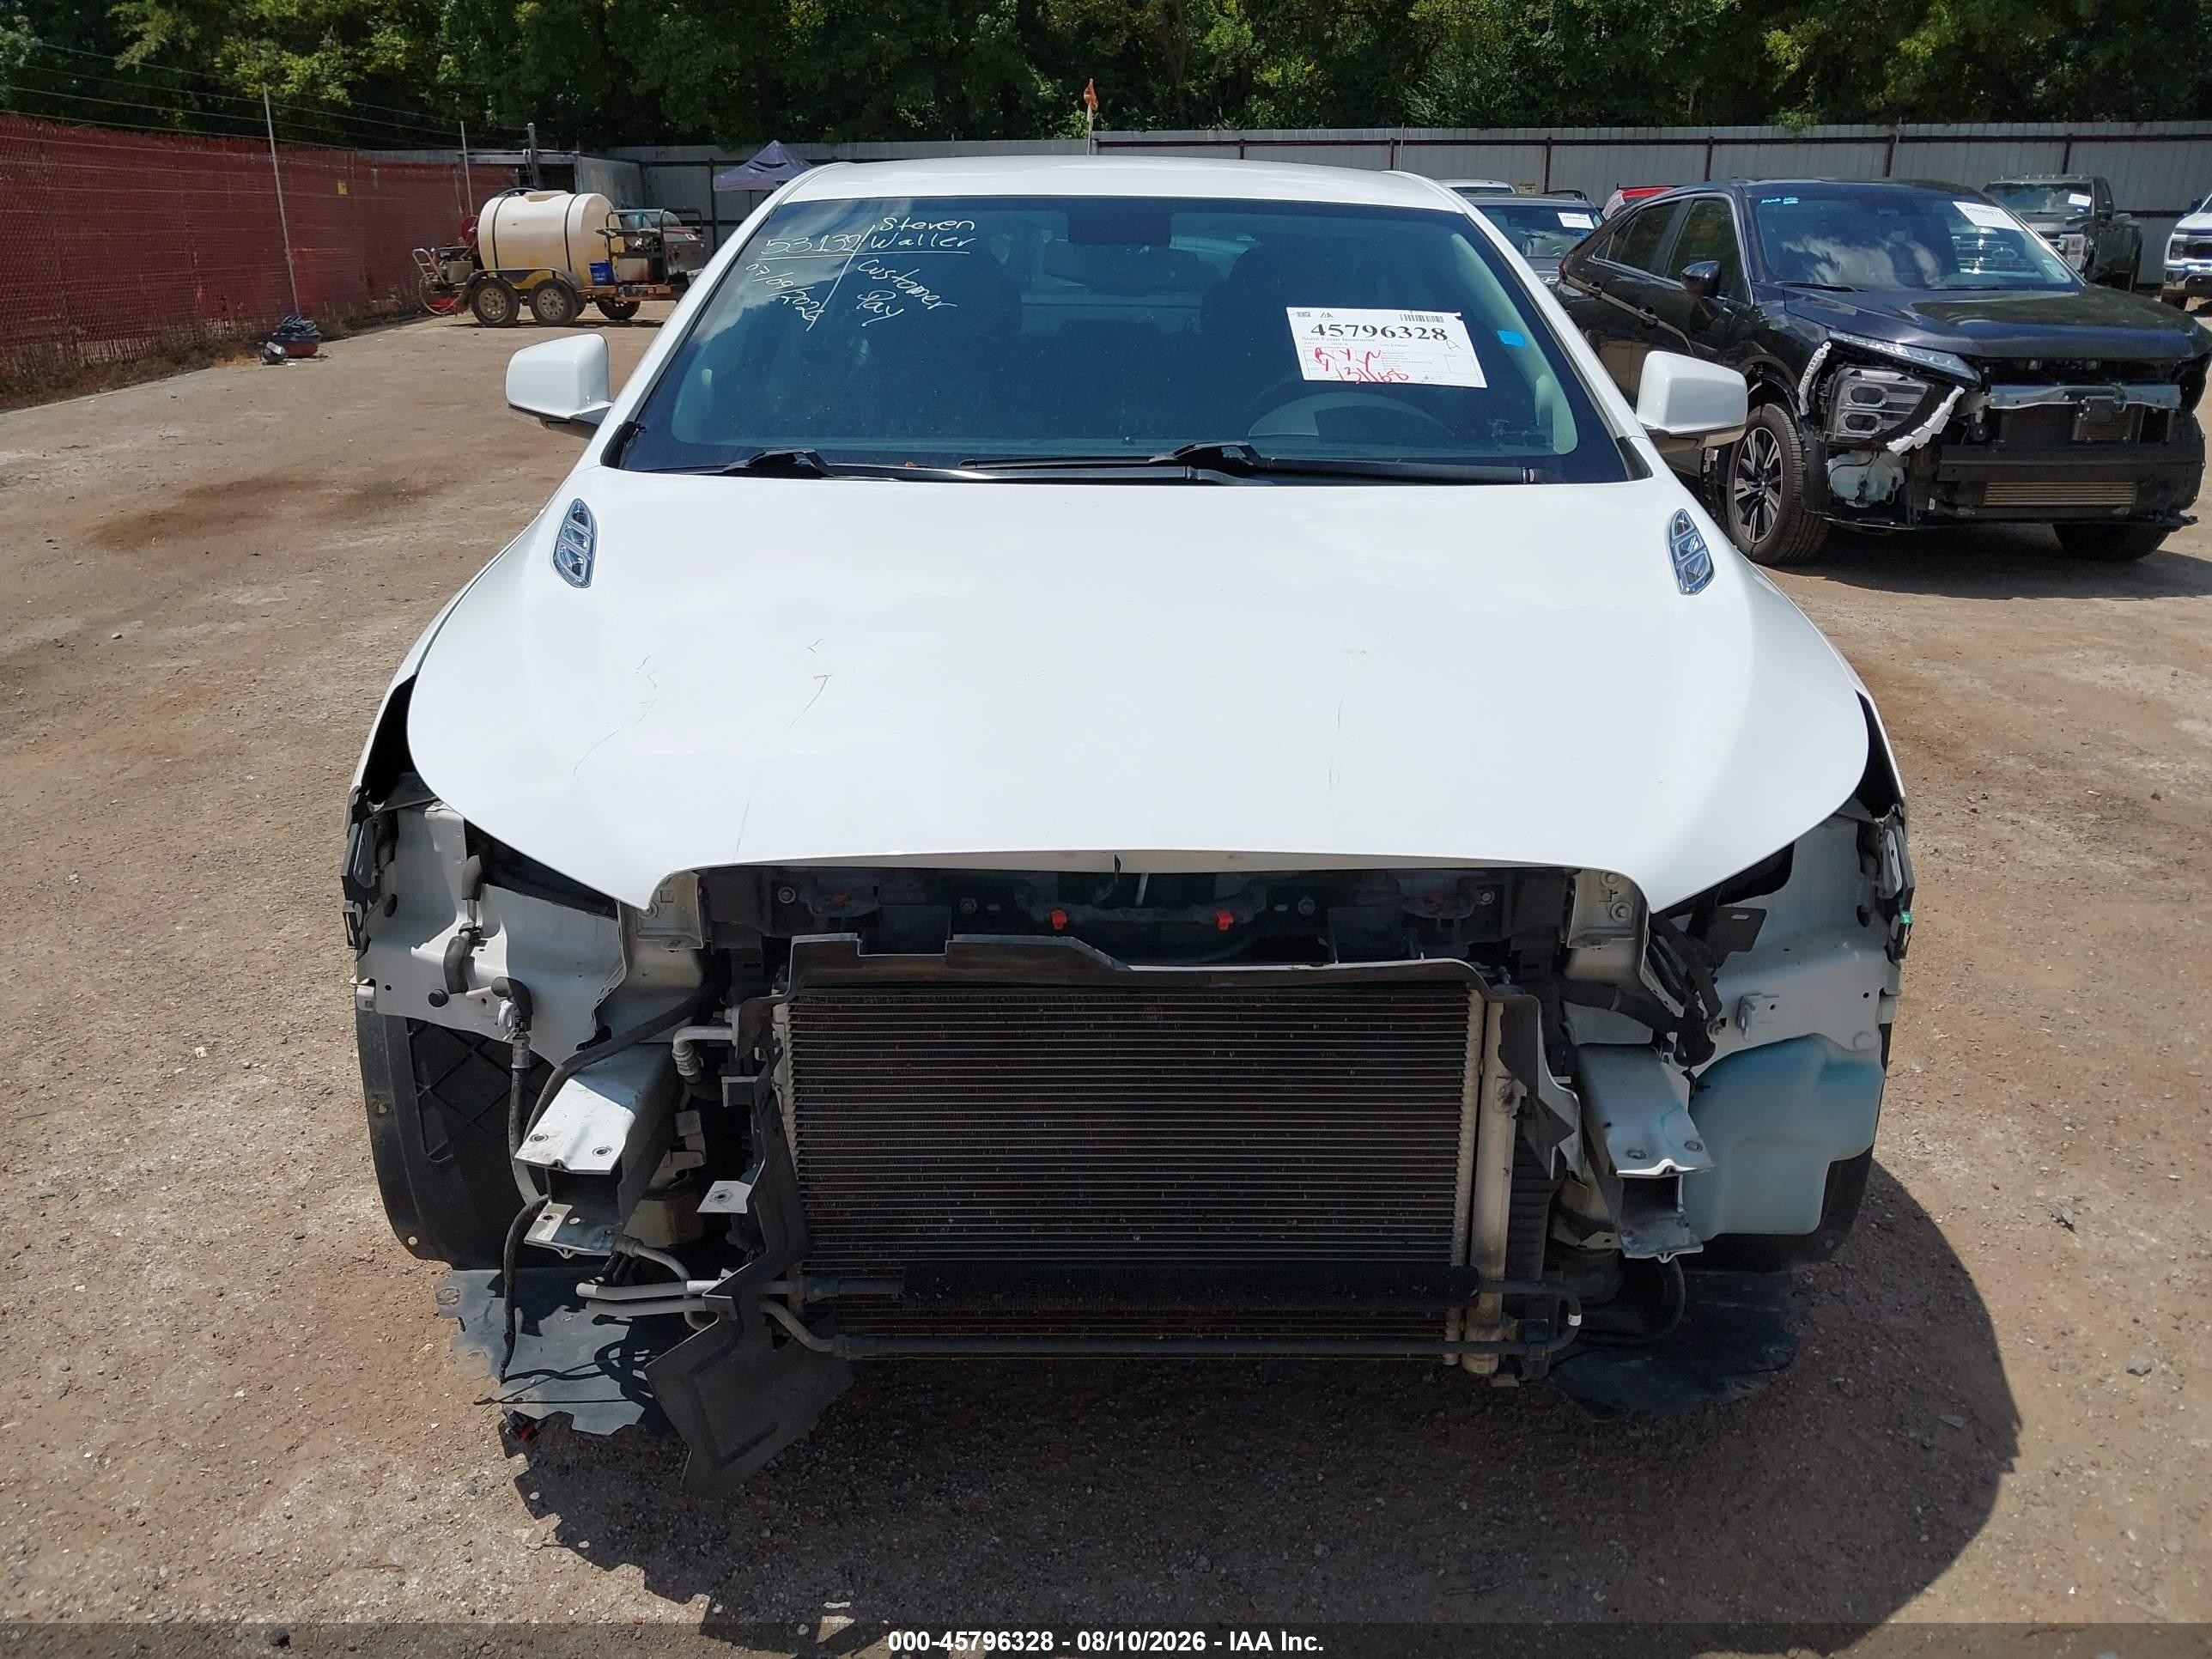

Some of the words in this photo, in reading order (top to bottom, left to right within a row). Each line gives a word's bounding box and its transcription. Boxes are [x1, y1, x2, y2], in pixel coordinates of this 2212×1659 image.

[879, 216, 975, 232] Steven
[760, 234, 861, 255] 53132
[870, 233, 978, 250] Waller
[857, 258, 958, 311] Customer
[856, 289, 904, 327] Pay
[1310, 323, 1449, 342] 45796328
